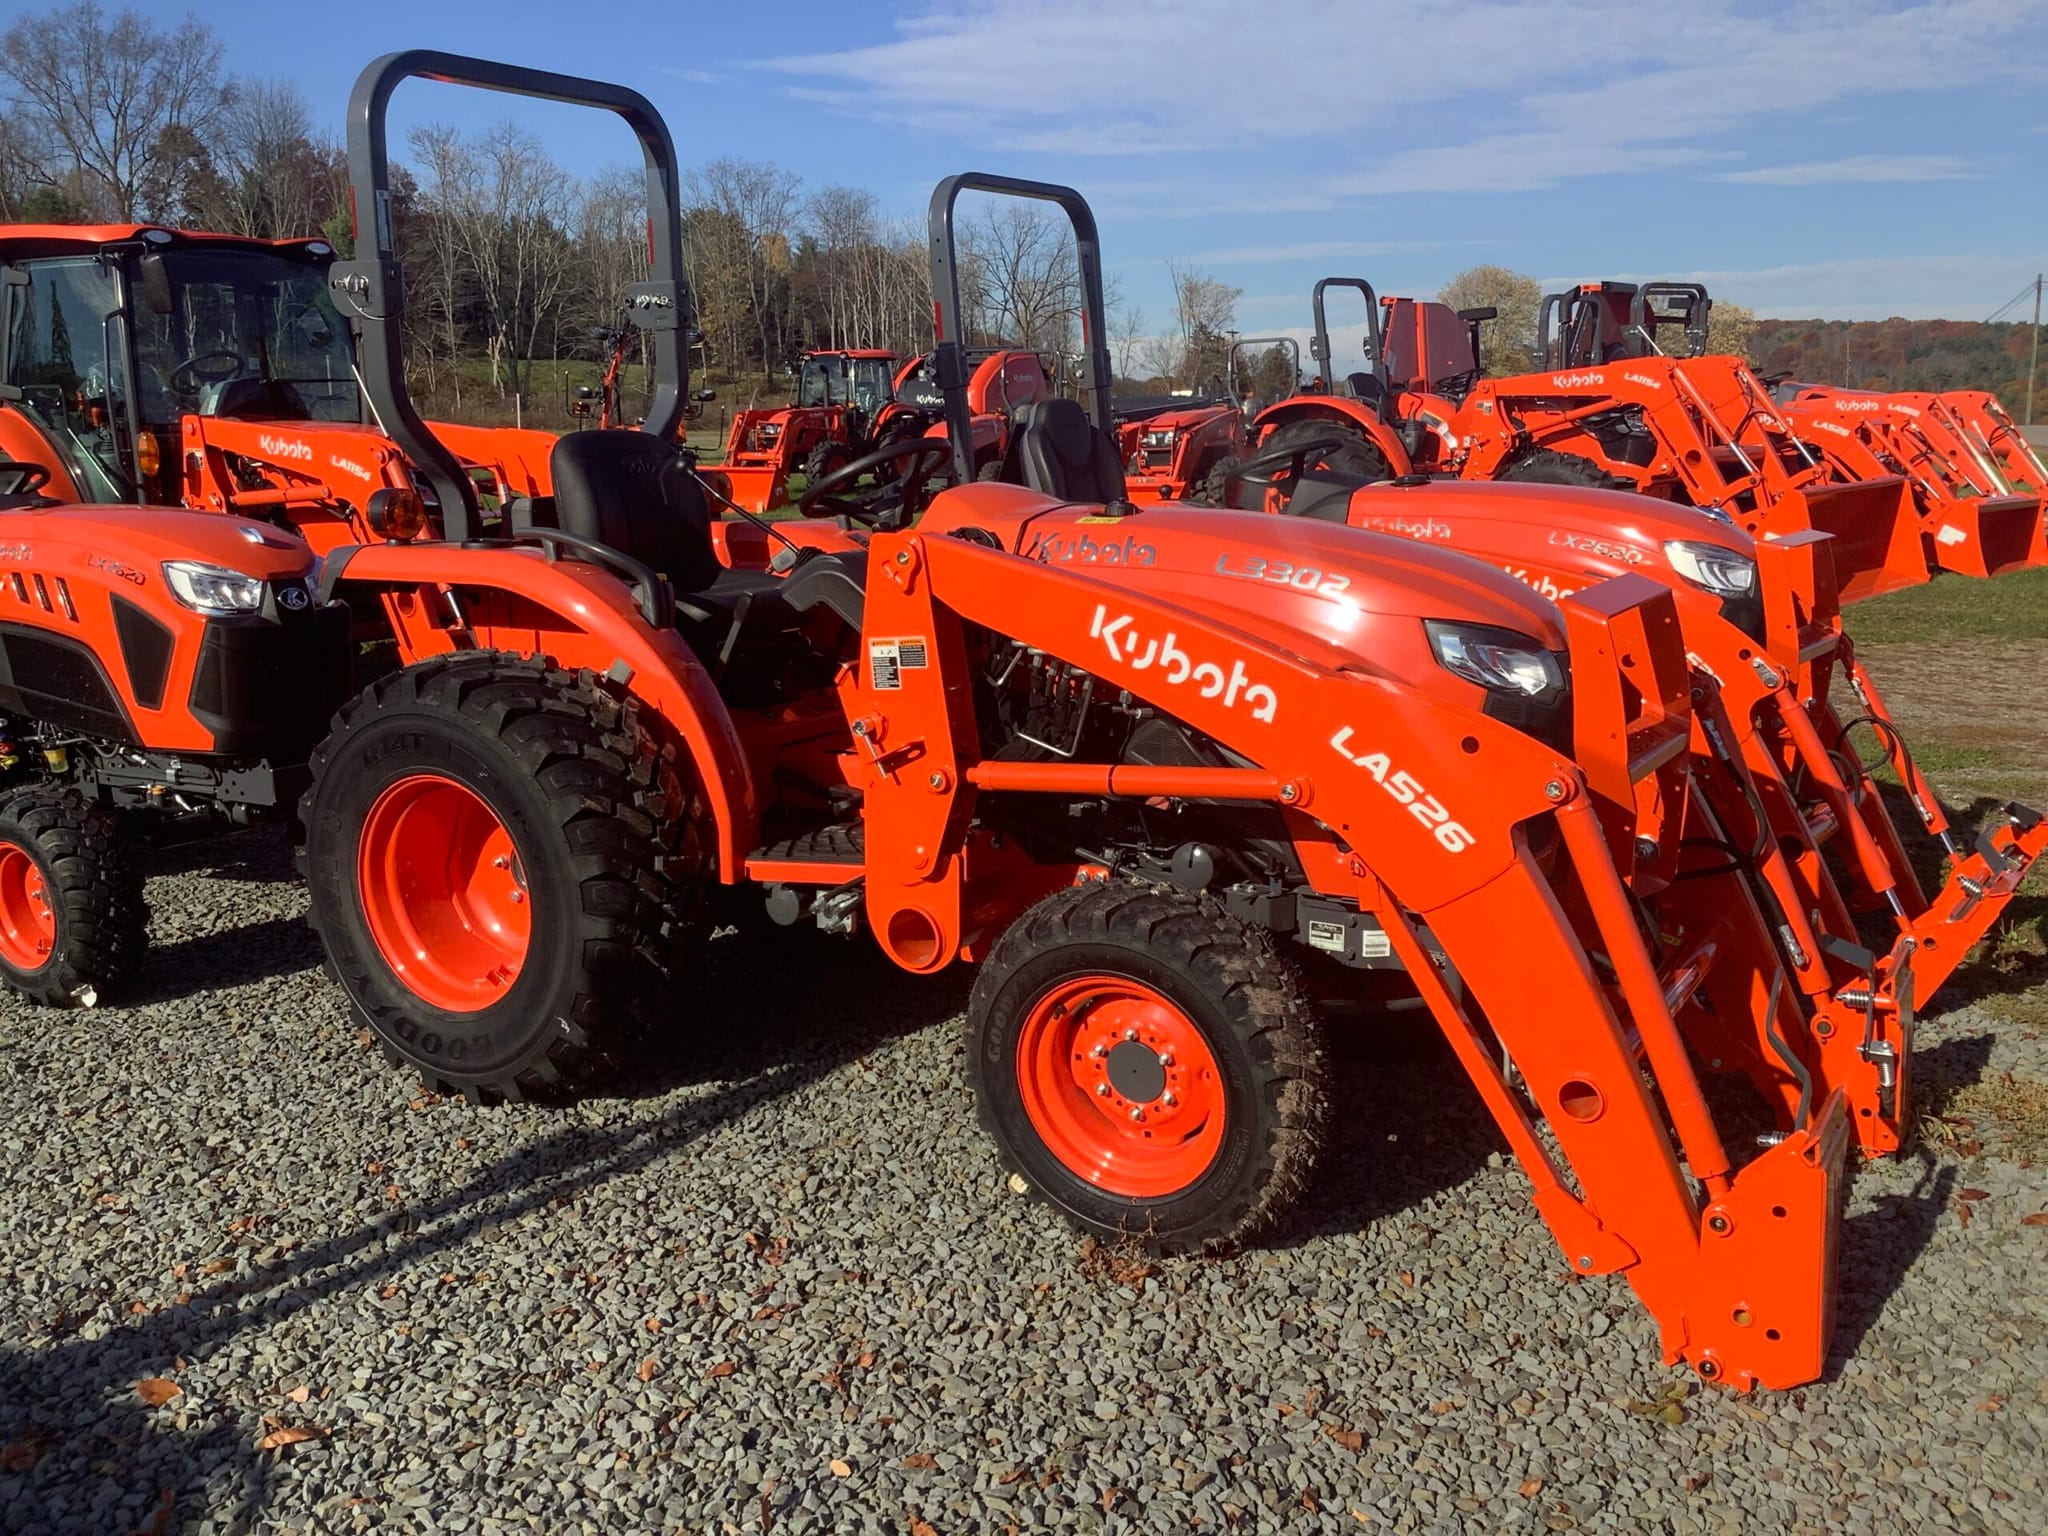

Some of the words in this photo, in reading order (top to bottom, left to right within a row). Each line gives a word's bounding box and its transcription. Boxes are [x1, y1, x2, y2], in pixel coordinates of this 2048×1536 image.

[1553, 371, 1604, 389] Kubota
[1835, 399, 1880, 412] Kubota
[260, 434, 313, 461] Kubota
[331, 455, 371, 482] LA1154
[1034, 531, 1158, 567] Kubota
[1548, 531, 1644, 566] LX2620
[86, 553, 147, 587] LX2620
[1215, 553, 1352, 602] L3302
[1089, 604, 1278, 725] Kubota
[1330, 725, 1476, 853] LA526
